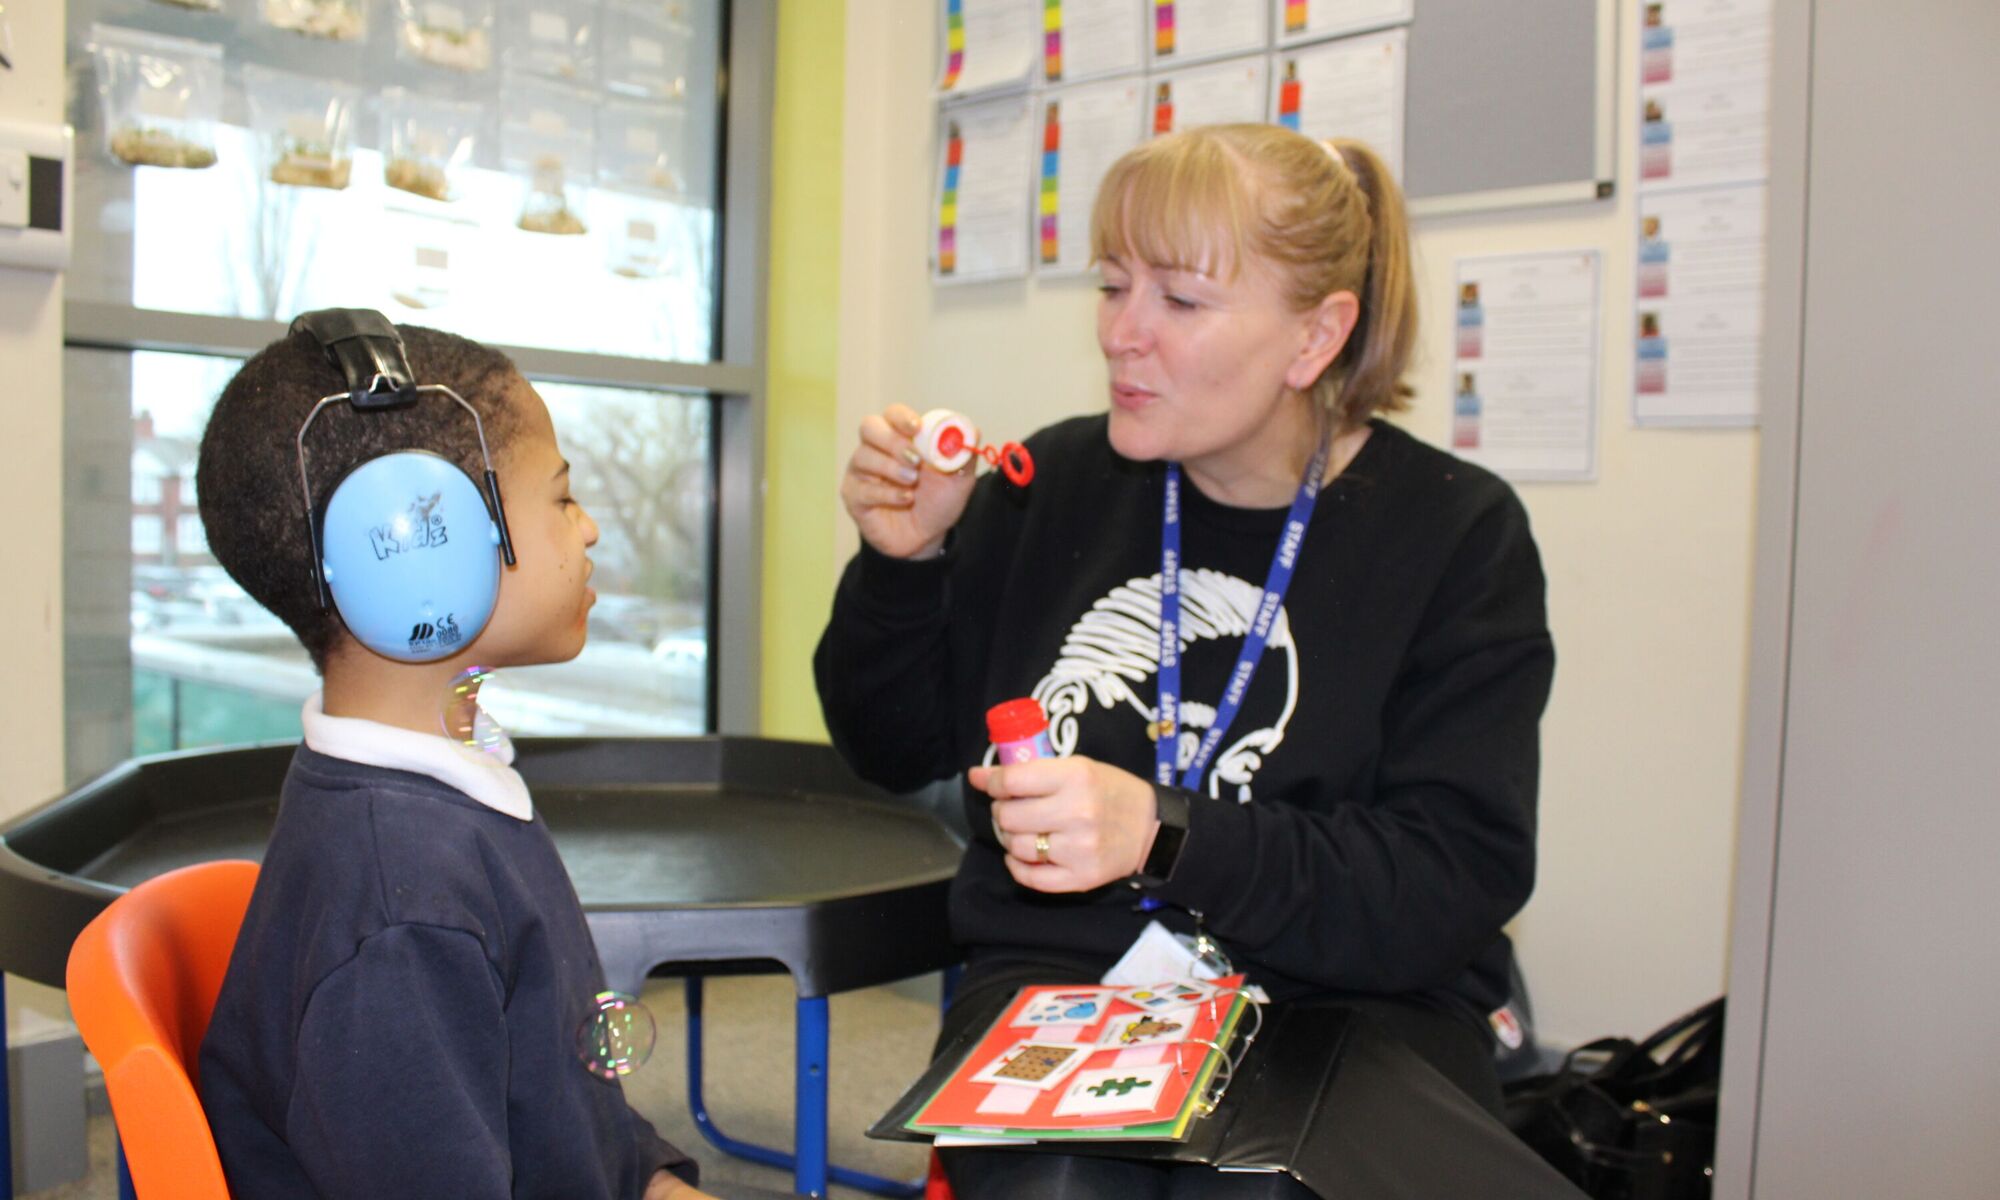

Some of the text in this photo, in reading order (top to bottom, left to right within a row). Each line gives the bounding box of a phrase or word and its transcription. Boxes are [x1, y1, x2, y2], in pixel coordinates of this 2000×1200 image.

[1164, 478, 1178, 525] STAFF
[1278, 519, 1304, 570] STAFF
[1163, 548, 1177, 595] STAFF
[1255, 591, 1280, 638] STAFF
[1161, 620, 1176, 668] STAFF
[1227, 660, 1253, 705] STAFF
[1195, 727, 1222, 769] STAFF
